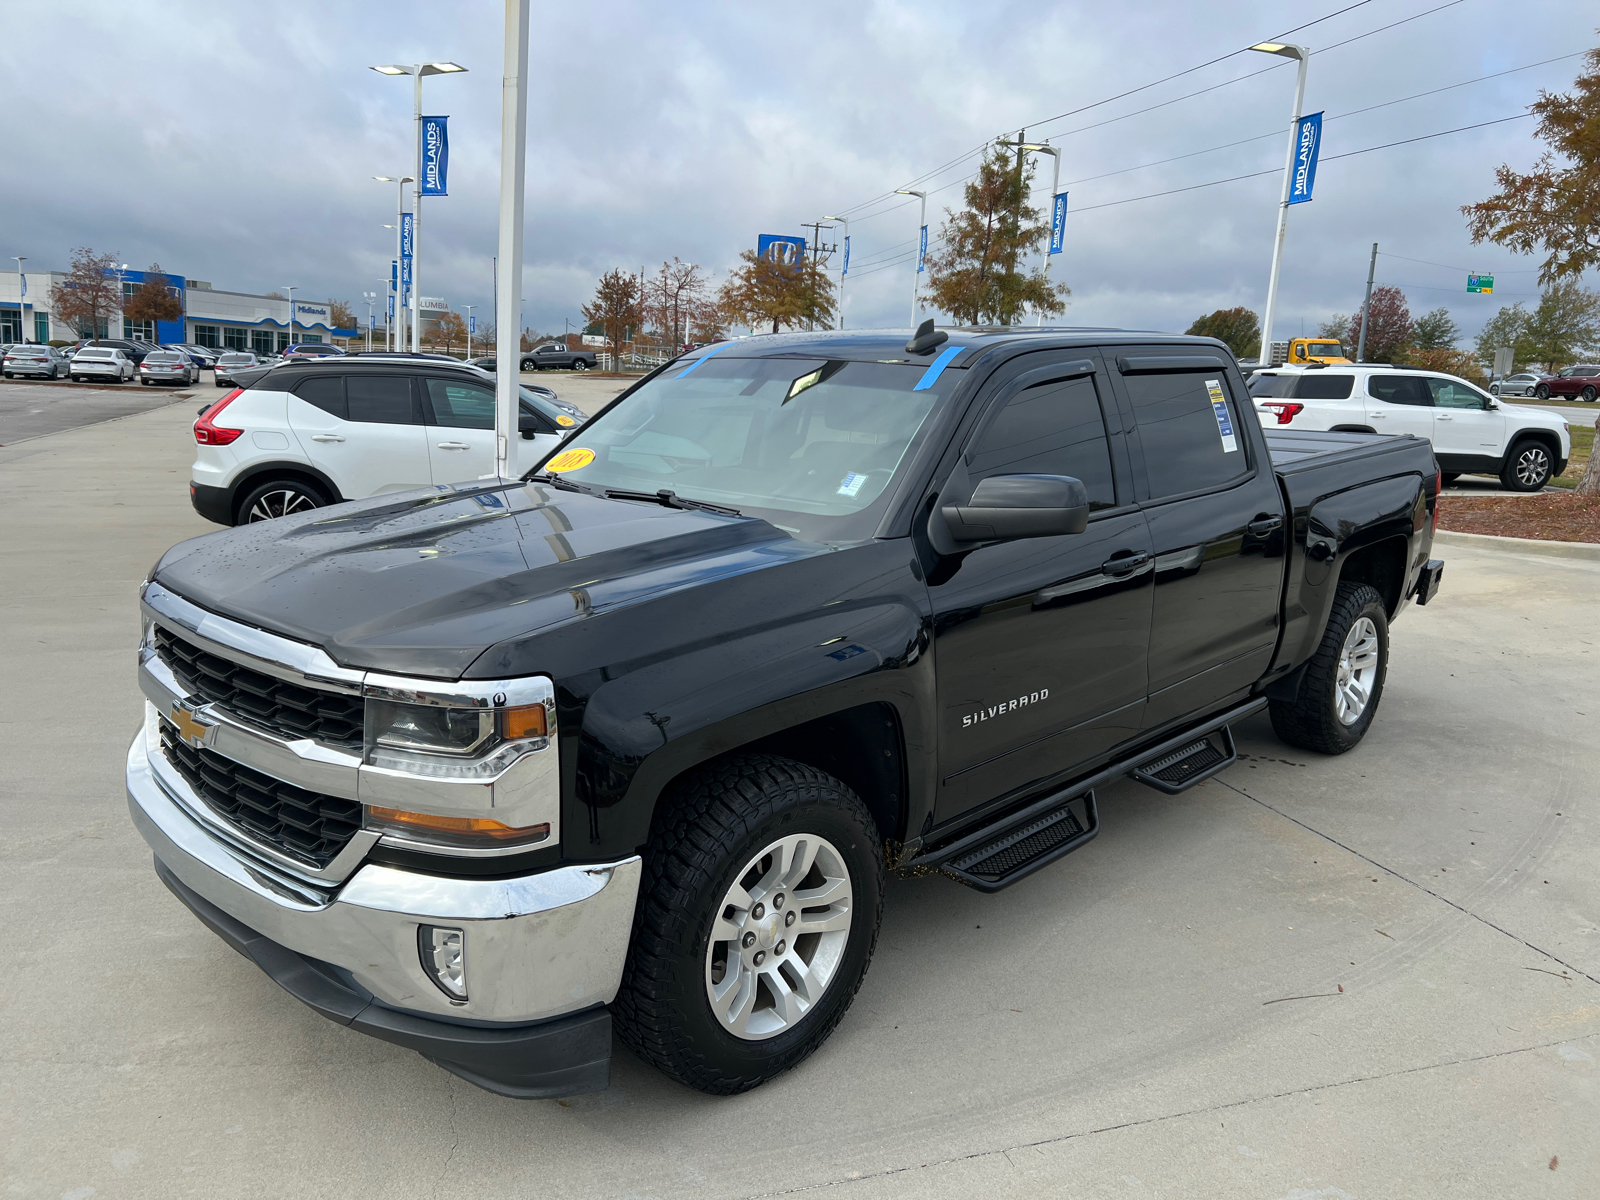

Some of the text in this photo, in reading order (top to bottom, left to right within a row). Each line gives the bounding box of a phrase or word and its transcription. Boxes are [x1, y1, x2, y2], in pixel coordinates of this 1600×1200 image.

[426, 122, 436, 188] MIDLANDS
[1294, 121, 1311, 195] MIDLANDS
[1052, 198, 1062, 248] MIDLANDS
[297, 305, 327, 315] Midlands
[420, 301, 449, 310] LUMBIA
[962, 688, 1049, 728] SILVERADO
